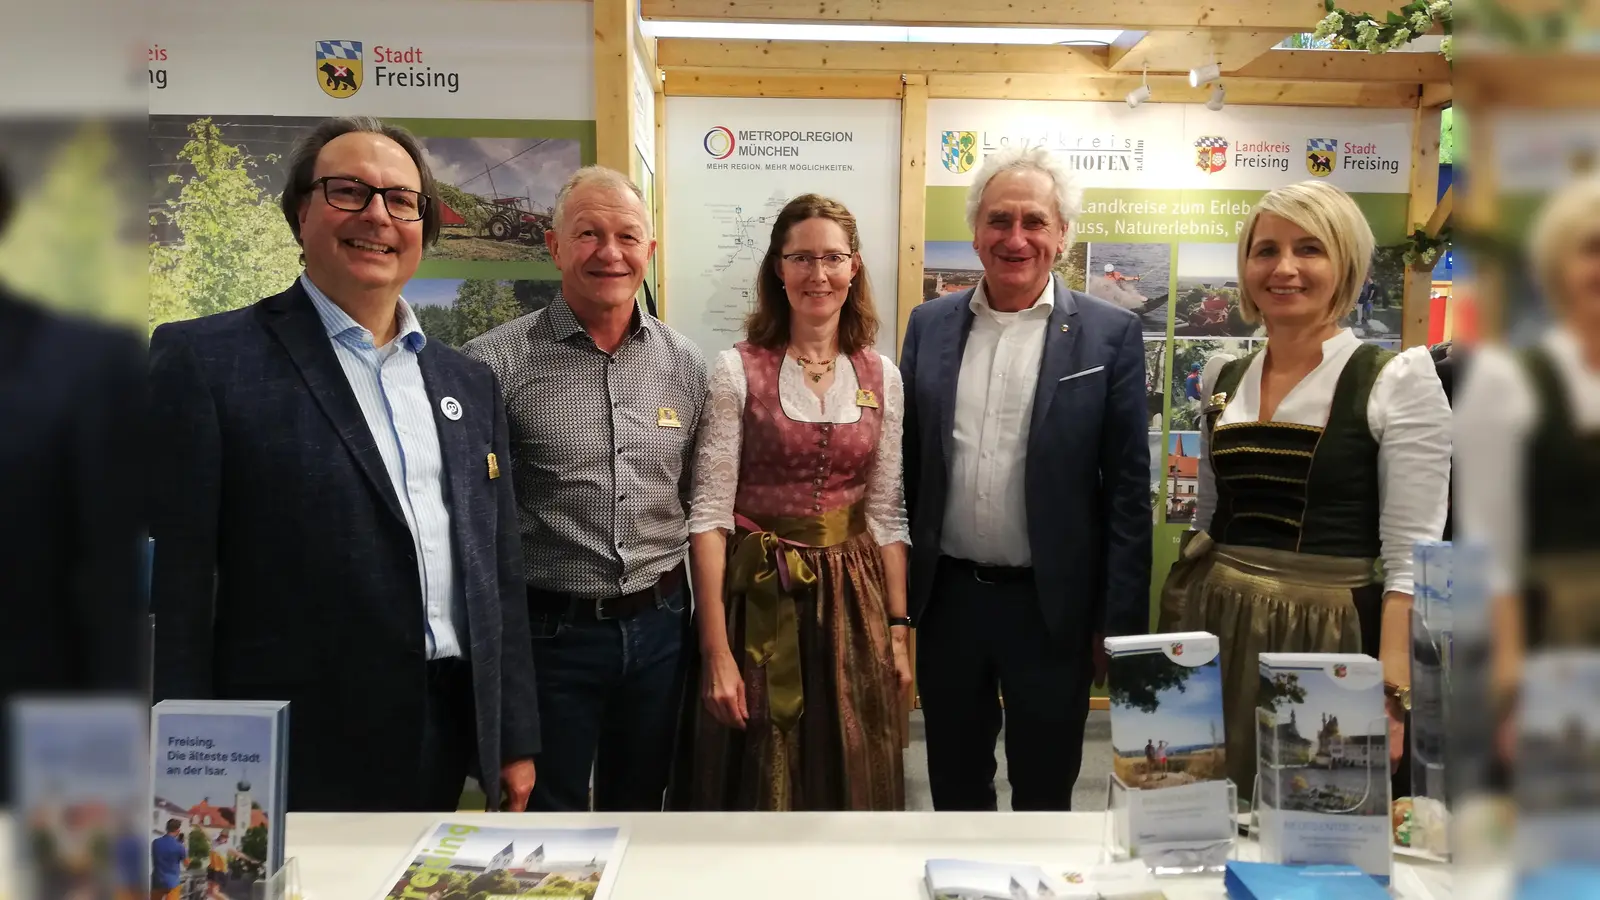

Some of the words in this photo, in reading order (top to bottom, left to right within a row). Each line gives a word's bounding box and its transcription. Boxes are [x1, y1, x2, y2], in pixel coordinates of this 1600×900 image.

[373, 46, 423, 63] Stadt
[375, 66, 459, 93] Freising
[738, 130, 853, 142] METROPOLREGION
[738, 143, 799, 157] MÜNCHEN
[1235, 140, 1291, 154] Landkreis
[1343, 142, 1377, 155] Stadt
[731, 163, 763, 171] REGION.
[765, 163, 788, 171] MEHR
[789, 162, 855, 172] MÖGLICHKEITEN.
[1235, 154, 1290, 172] Freising
[1343, 155, 1400, 174] Freising
[1080, 199, 1166, 215] Landkreise
[1172, 203, 1205, 215] zum
[1115, 220, 1229, 237] Naturerlebnis,
[168, 736, 216, 749] Freising.
[167, 751, 186, 761] Die
[188, 751, 229, 762] älteste
[230, 752, 261, 763] Stadt
[166, 766, 181, 775] an
[183, 765, 202, 775] der
[204, 766, 228, 776] Isar.
